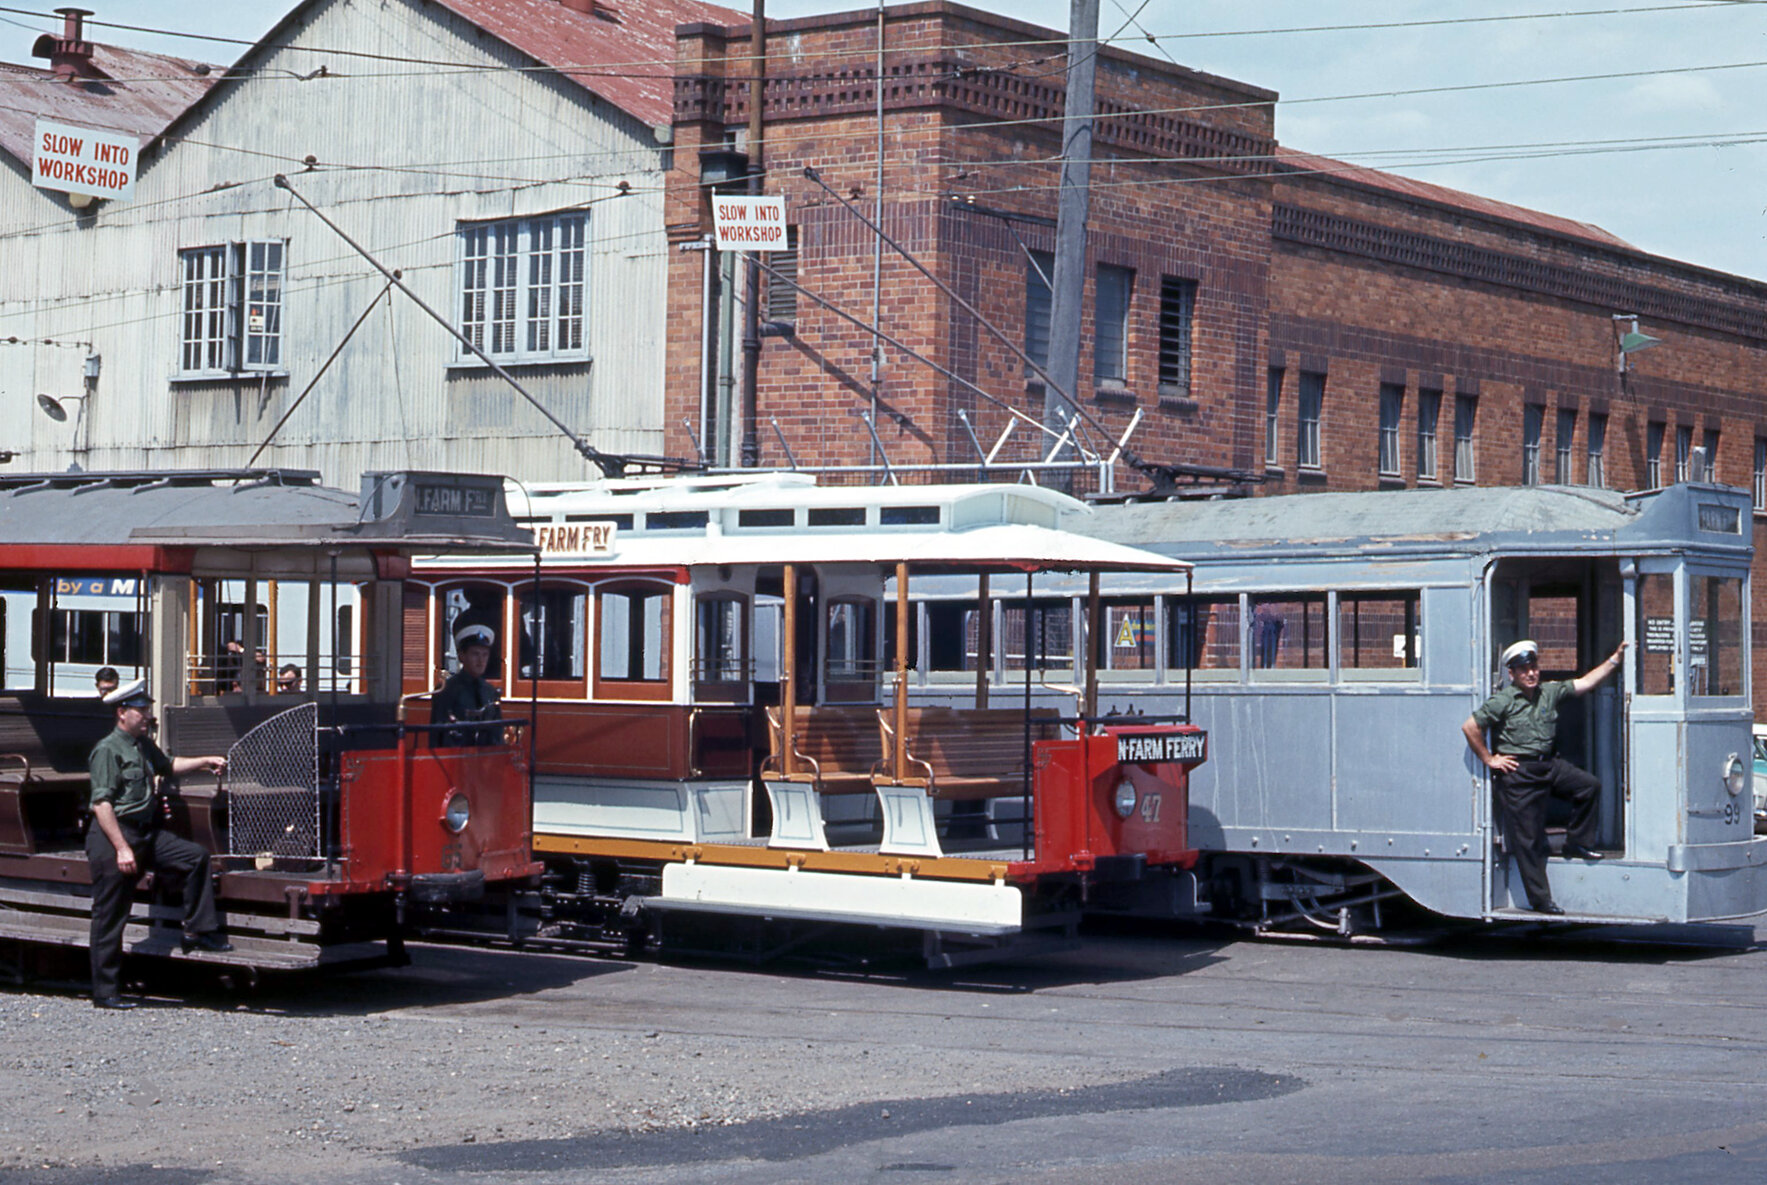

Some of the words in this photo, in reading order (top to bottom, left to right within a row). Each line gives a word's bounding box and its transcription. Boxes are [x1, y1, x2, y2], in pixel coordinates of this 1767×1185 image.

[42, 132, 84, 157] SLOW
[94, 142, 129, 166] INTO
[38, 157, 129, 191] WORKSHOP
[718, 204, 747, 221] SLOW
[755, 205, 780, 221] INTO
[718, 225, 782, 242] WORKSHOP
[538, 526, 580, 553] FARM
[581, 525, 611, 552] FRY
[57, 578, 83, 595] by
[90, 582, 105, 594] a
[1166, 736, 1205, 759] FERRY
[1140, 793, 1162, 823] 47
[1724, 803, 1740, 826] 99
